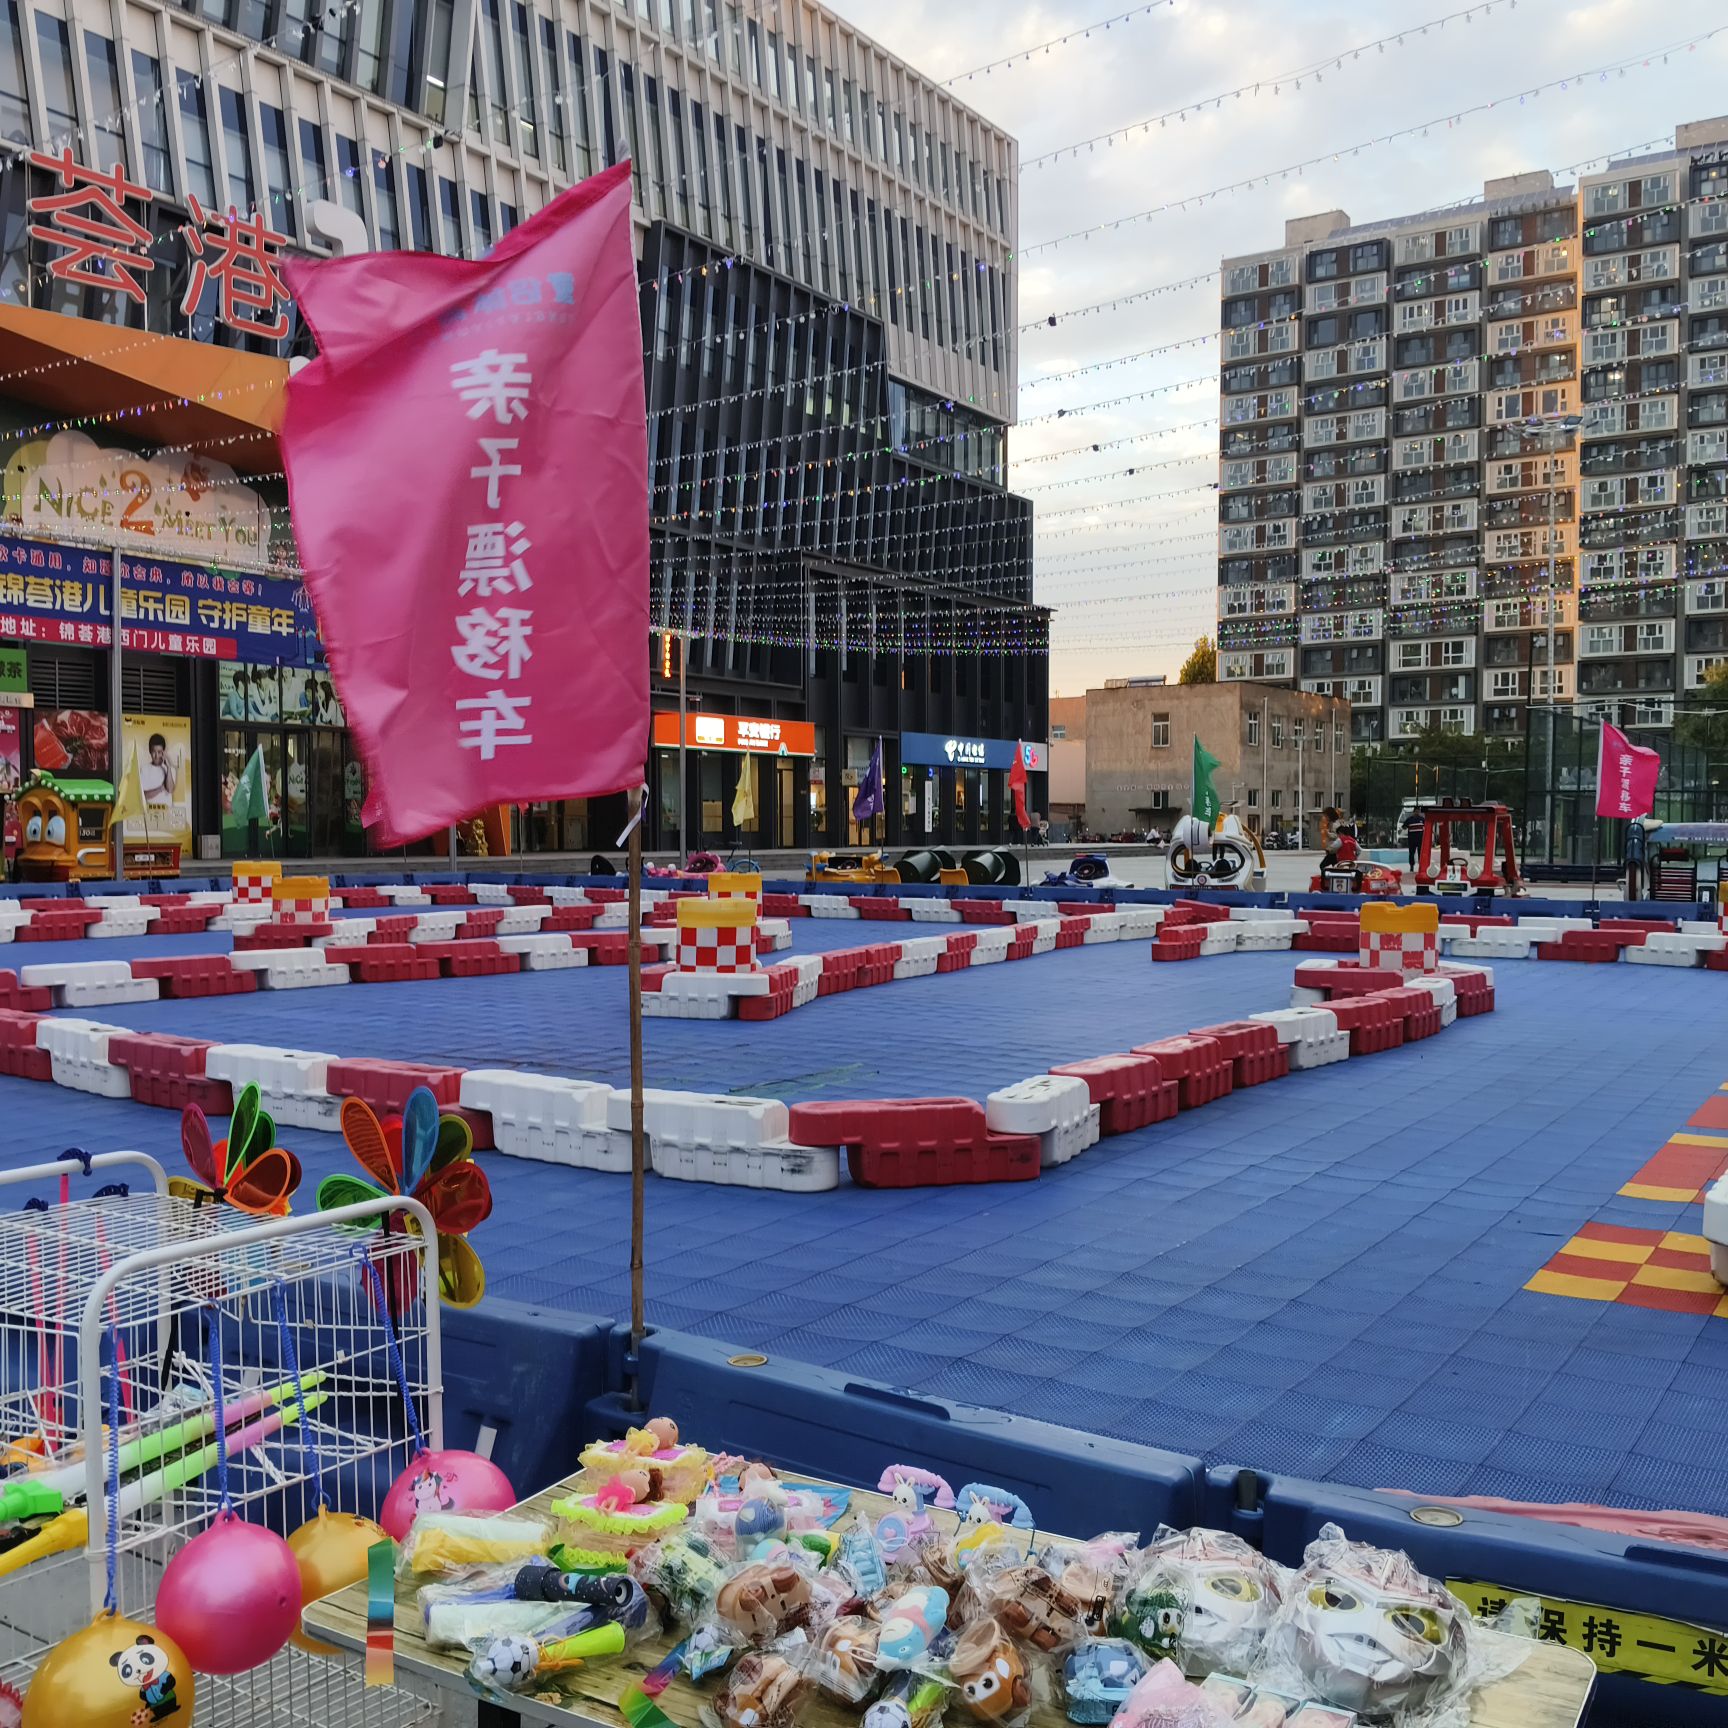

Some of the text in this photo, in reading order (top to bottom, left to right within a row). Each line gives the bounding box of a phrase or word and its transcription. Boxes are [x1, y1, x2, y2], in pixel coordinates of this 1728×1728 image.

[120, 470, 155, 535] 2
[0, 572, 295, 637] 锦荟港儿童乐园 守护童年
[1024, 744, 1039, 768] 5G
